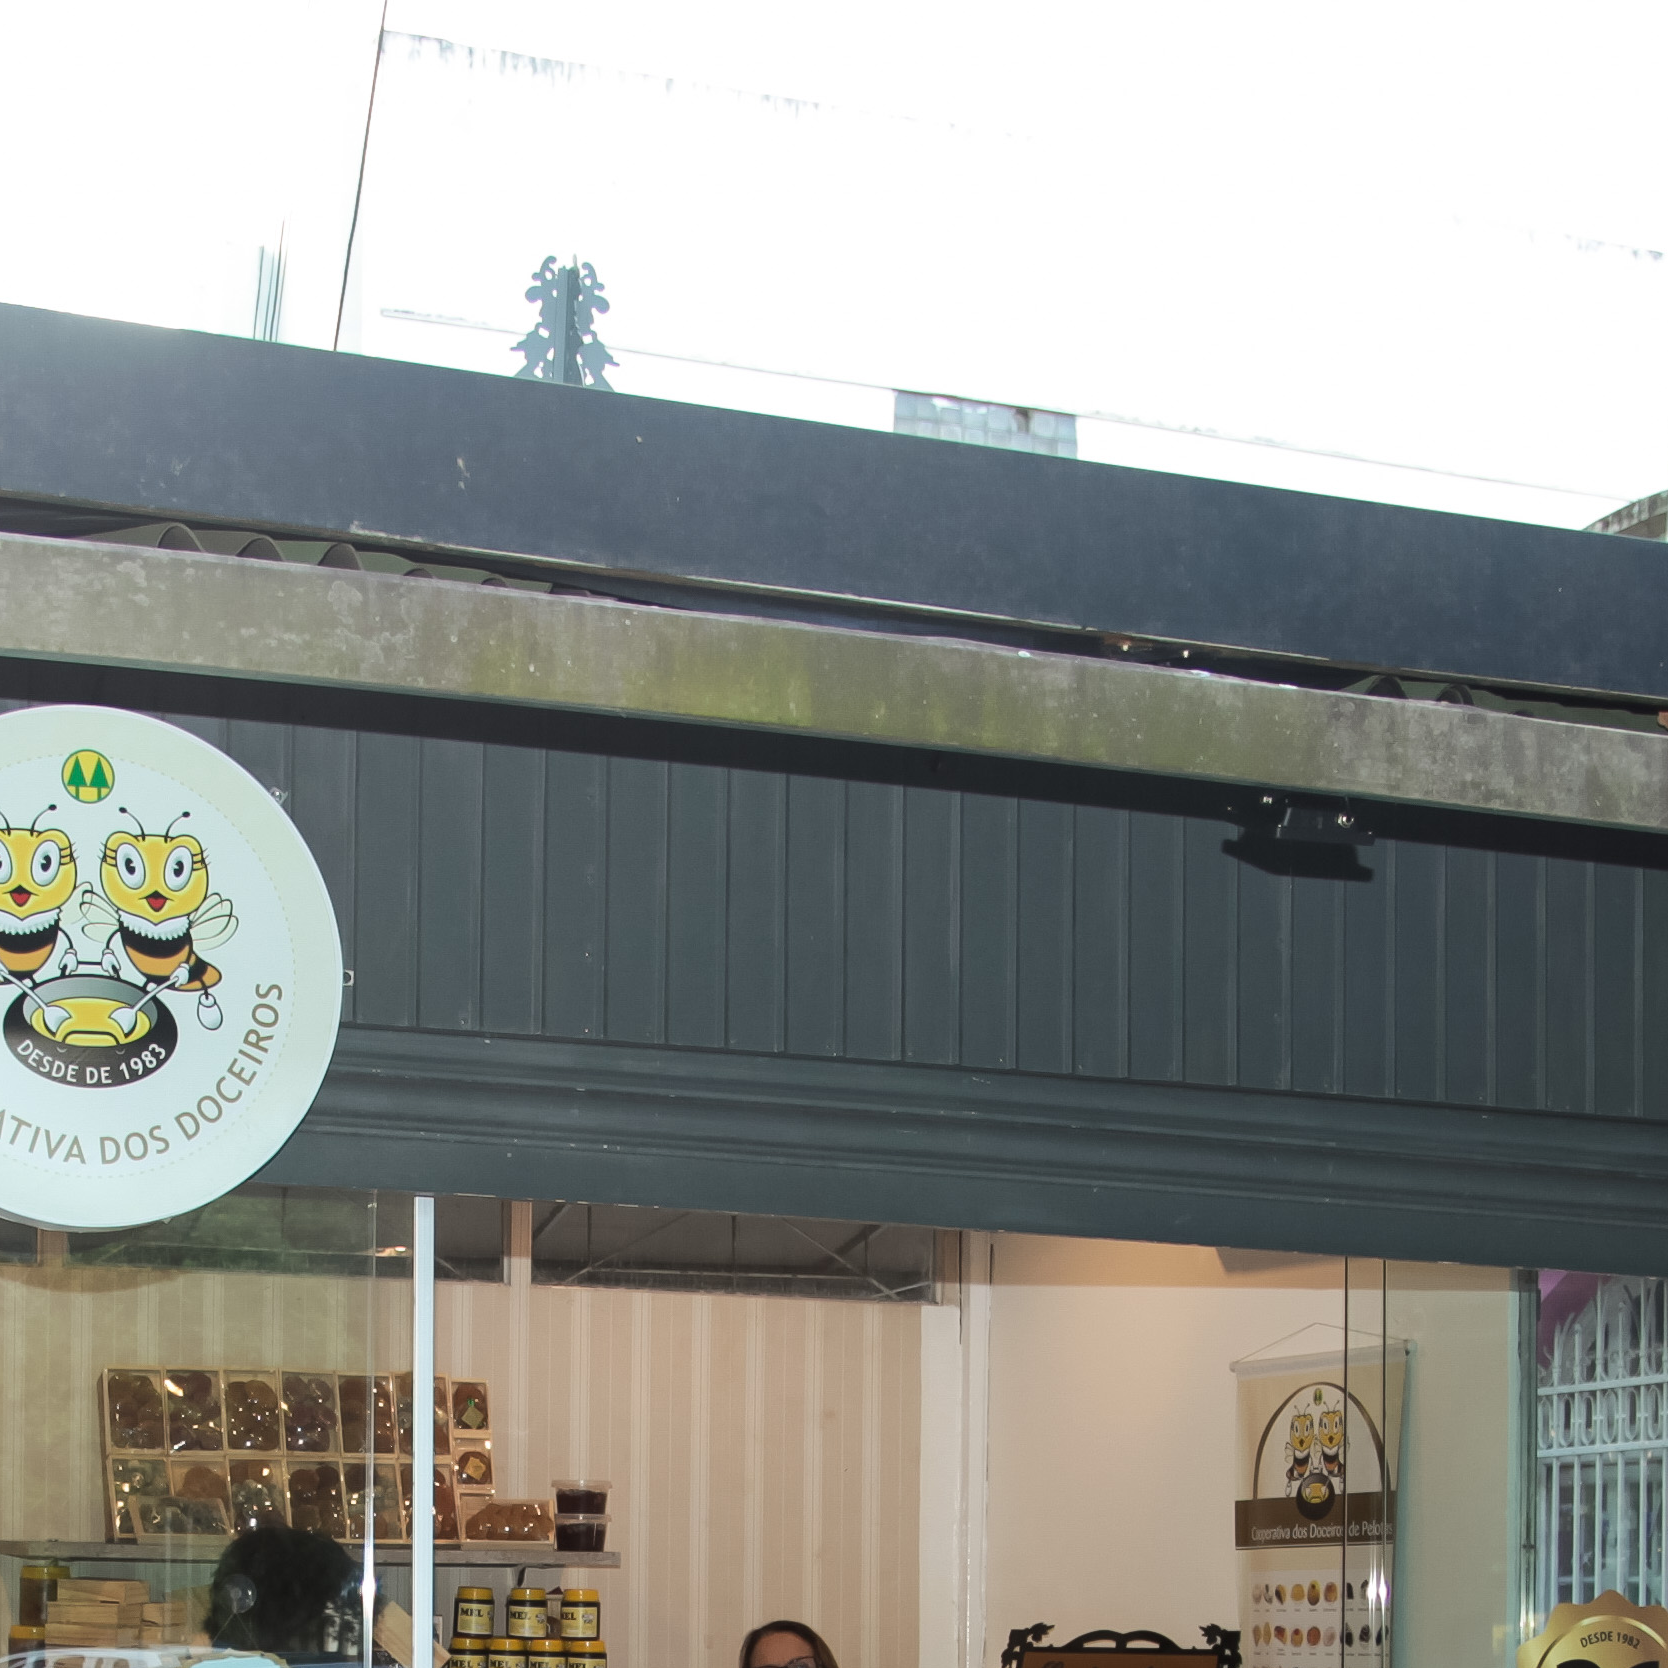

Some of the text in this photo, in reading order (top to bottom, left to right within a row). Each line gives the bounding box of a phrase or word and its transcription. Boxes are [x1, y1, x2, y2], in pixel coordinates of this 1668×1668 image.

[17, 1038, 168, 1084] DESDE DE 1983
[100, 1124, 171, 1166] DOS
[174, 981, 283, 1141] DOCEIROS
[1251, 1525, 1291, 1544] Cooperativa
[1292, 1524, 1308, 1539] dos
[1348, 1520, 1360, 1537] de
[460, 1606, 484, 1618] MEL
[509, 1611, 532, 1621] MEL
[1580, 1631, 1641, 1650] DESDE 1982
[451, 1659, 474, 1668] MEL
[489, 1659, 512, 1668] MEL
